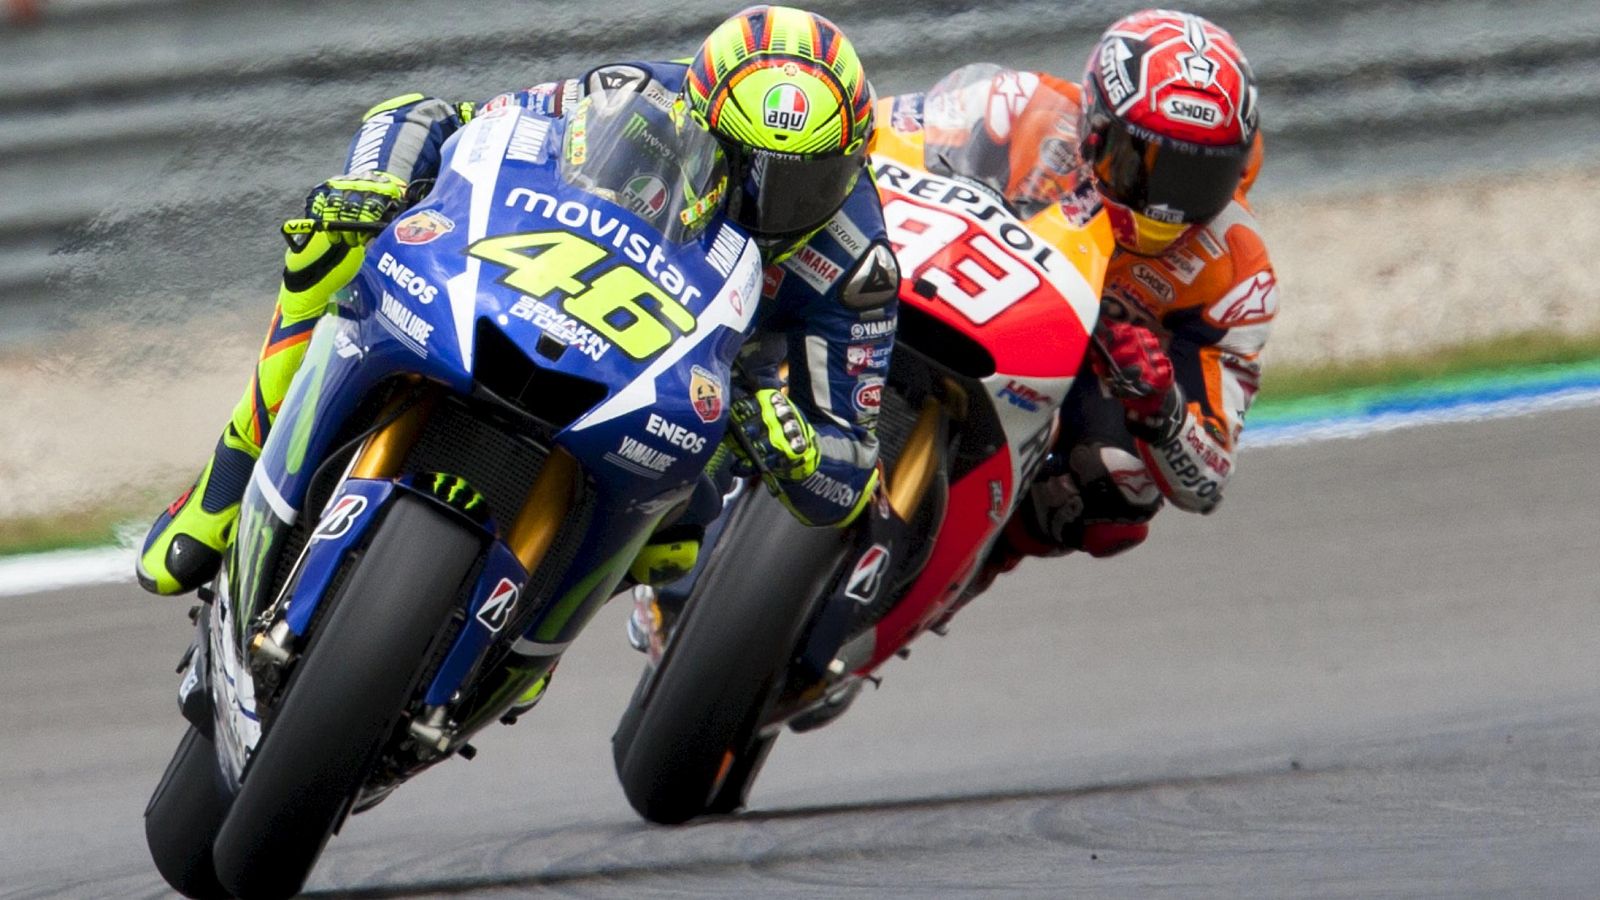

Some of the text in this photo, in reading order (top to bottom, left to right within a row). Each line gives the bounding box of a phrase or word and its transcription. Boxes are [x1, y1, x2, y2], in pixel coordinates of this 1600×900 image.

[1169, 99, 1217, 124] SHOEI
[876, 163, 1053, 273] REPSOL
[505, 187, 702, 306] movistar
[705, 222, 748, 279] YAMAHA
[795, 248, 839, 283] AMAHA
[883, 199, 1041, 325] 93
[377, 252, 438, 304] ENEOS
[466, 229, 698, 361] 46
[381, 290, 434, 346] YAMALUBE
[617, 436, 678, 473] YAMALUBE
[645, 413, 707, 454] ENEOS
[803, 471, 859, 508] movista
[1164, 438, 1226, 500] REPSO
